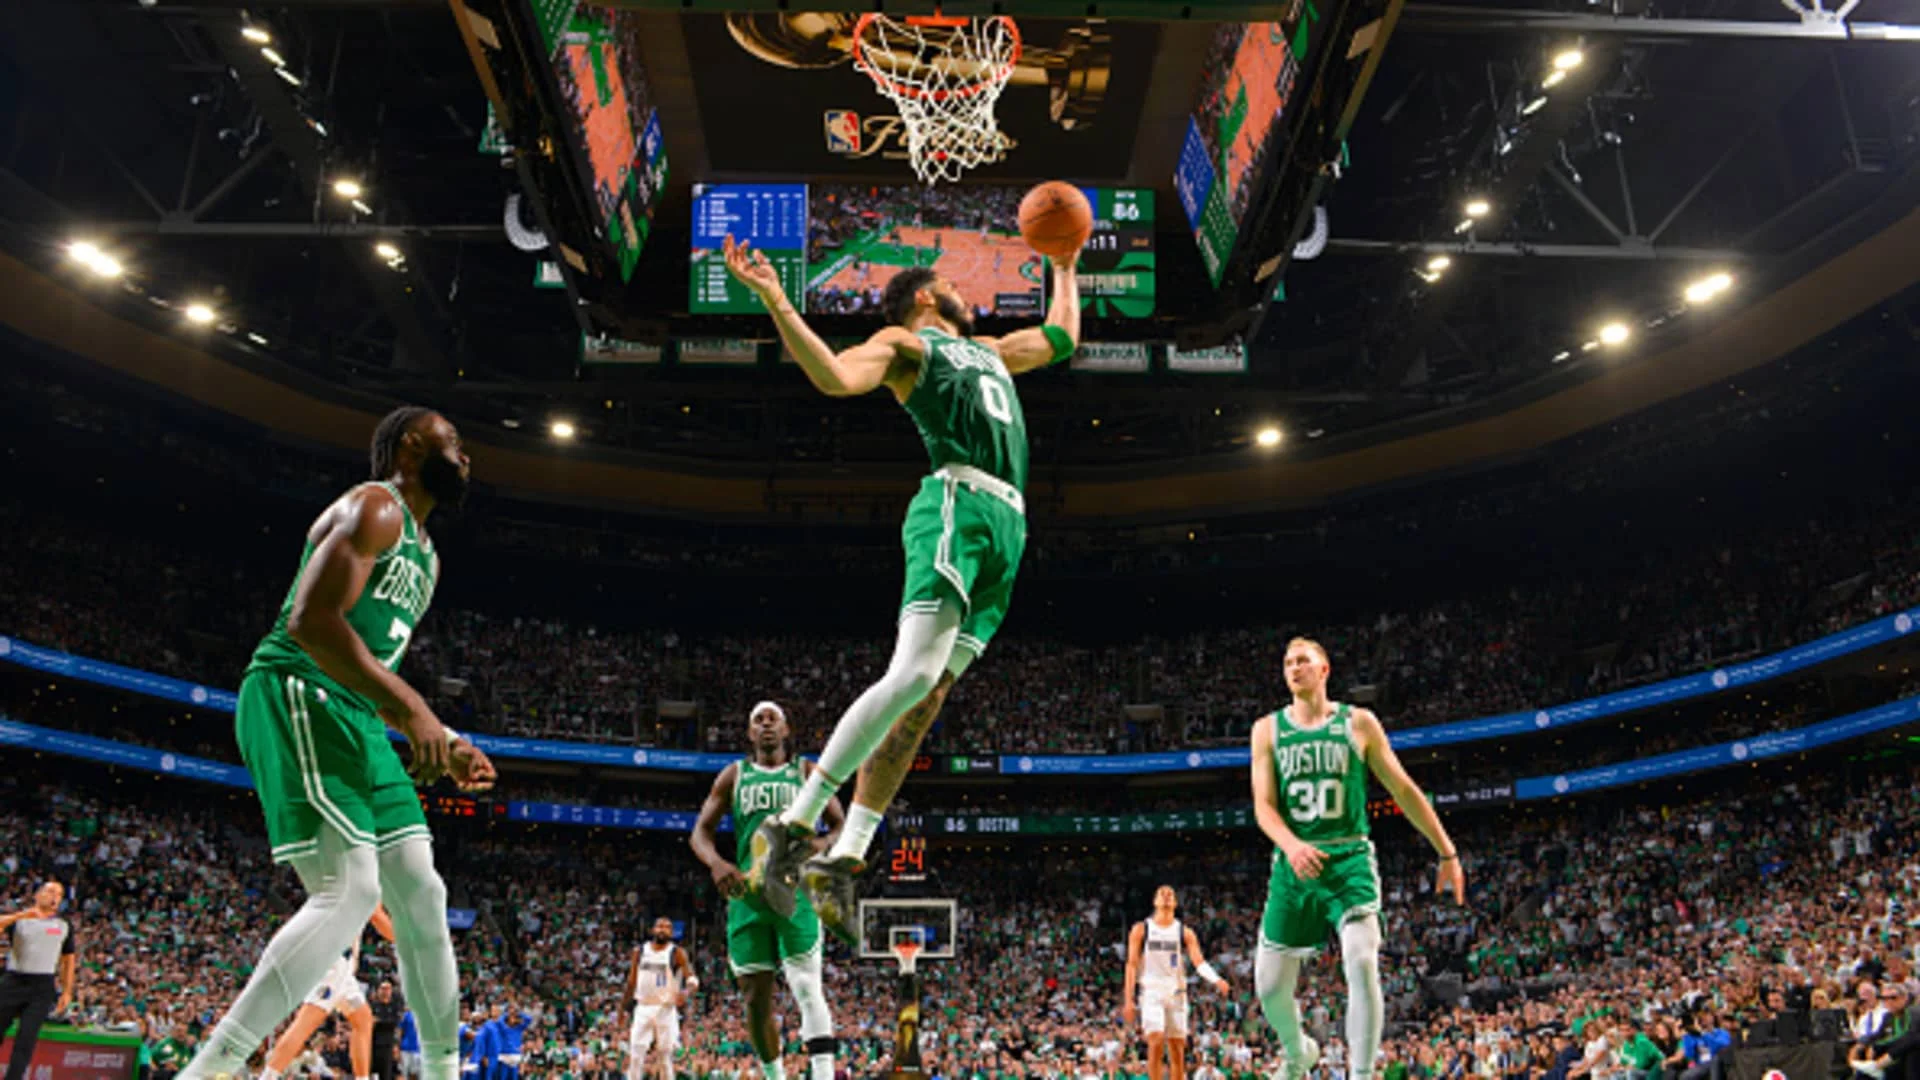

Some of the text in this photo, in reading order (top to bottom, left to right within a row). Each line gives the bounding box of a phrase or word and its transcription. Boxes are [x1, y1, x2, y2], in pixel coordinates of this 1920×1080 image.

[1113, 202, 1140, 220] 86
[979, 374, 1012, 424] 0
[380, 616, 412, 668] 7
[1277, 739, 1349, 780] BOSTON
[1287, 779, 1345, 822] 30
[891, 848, 924, 872] 24
